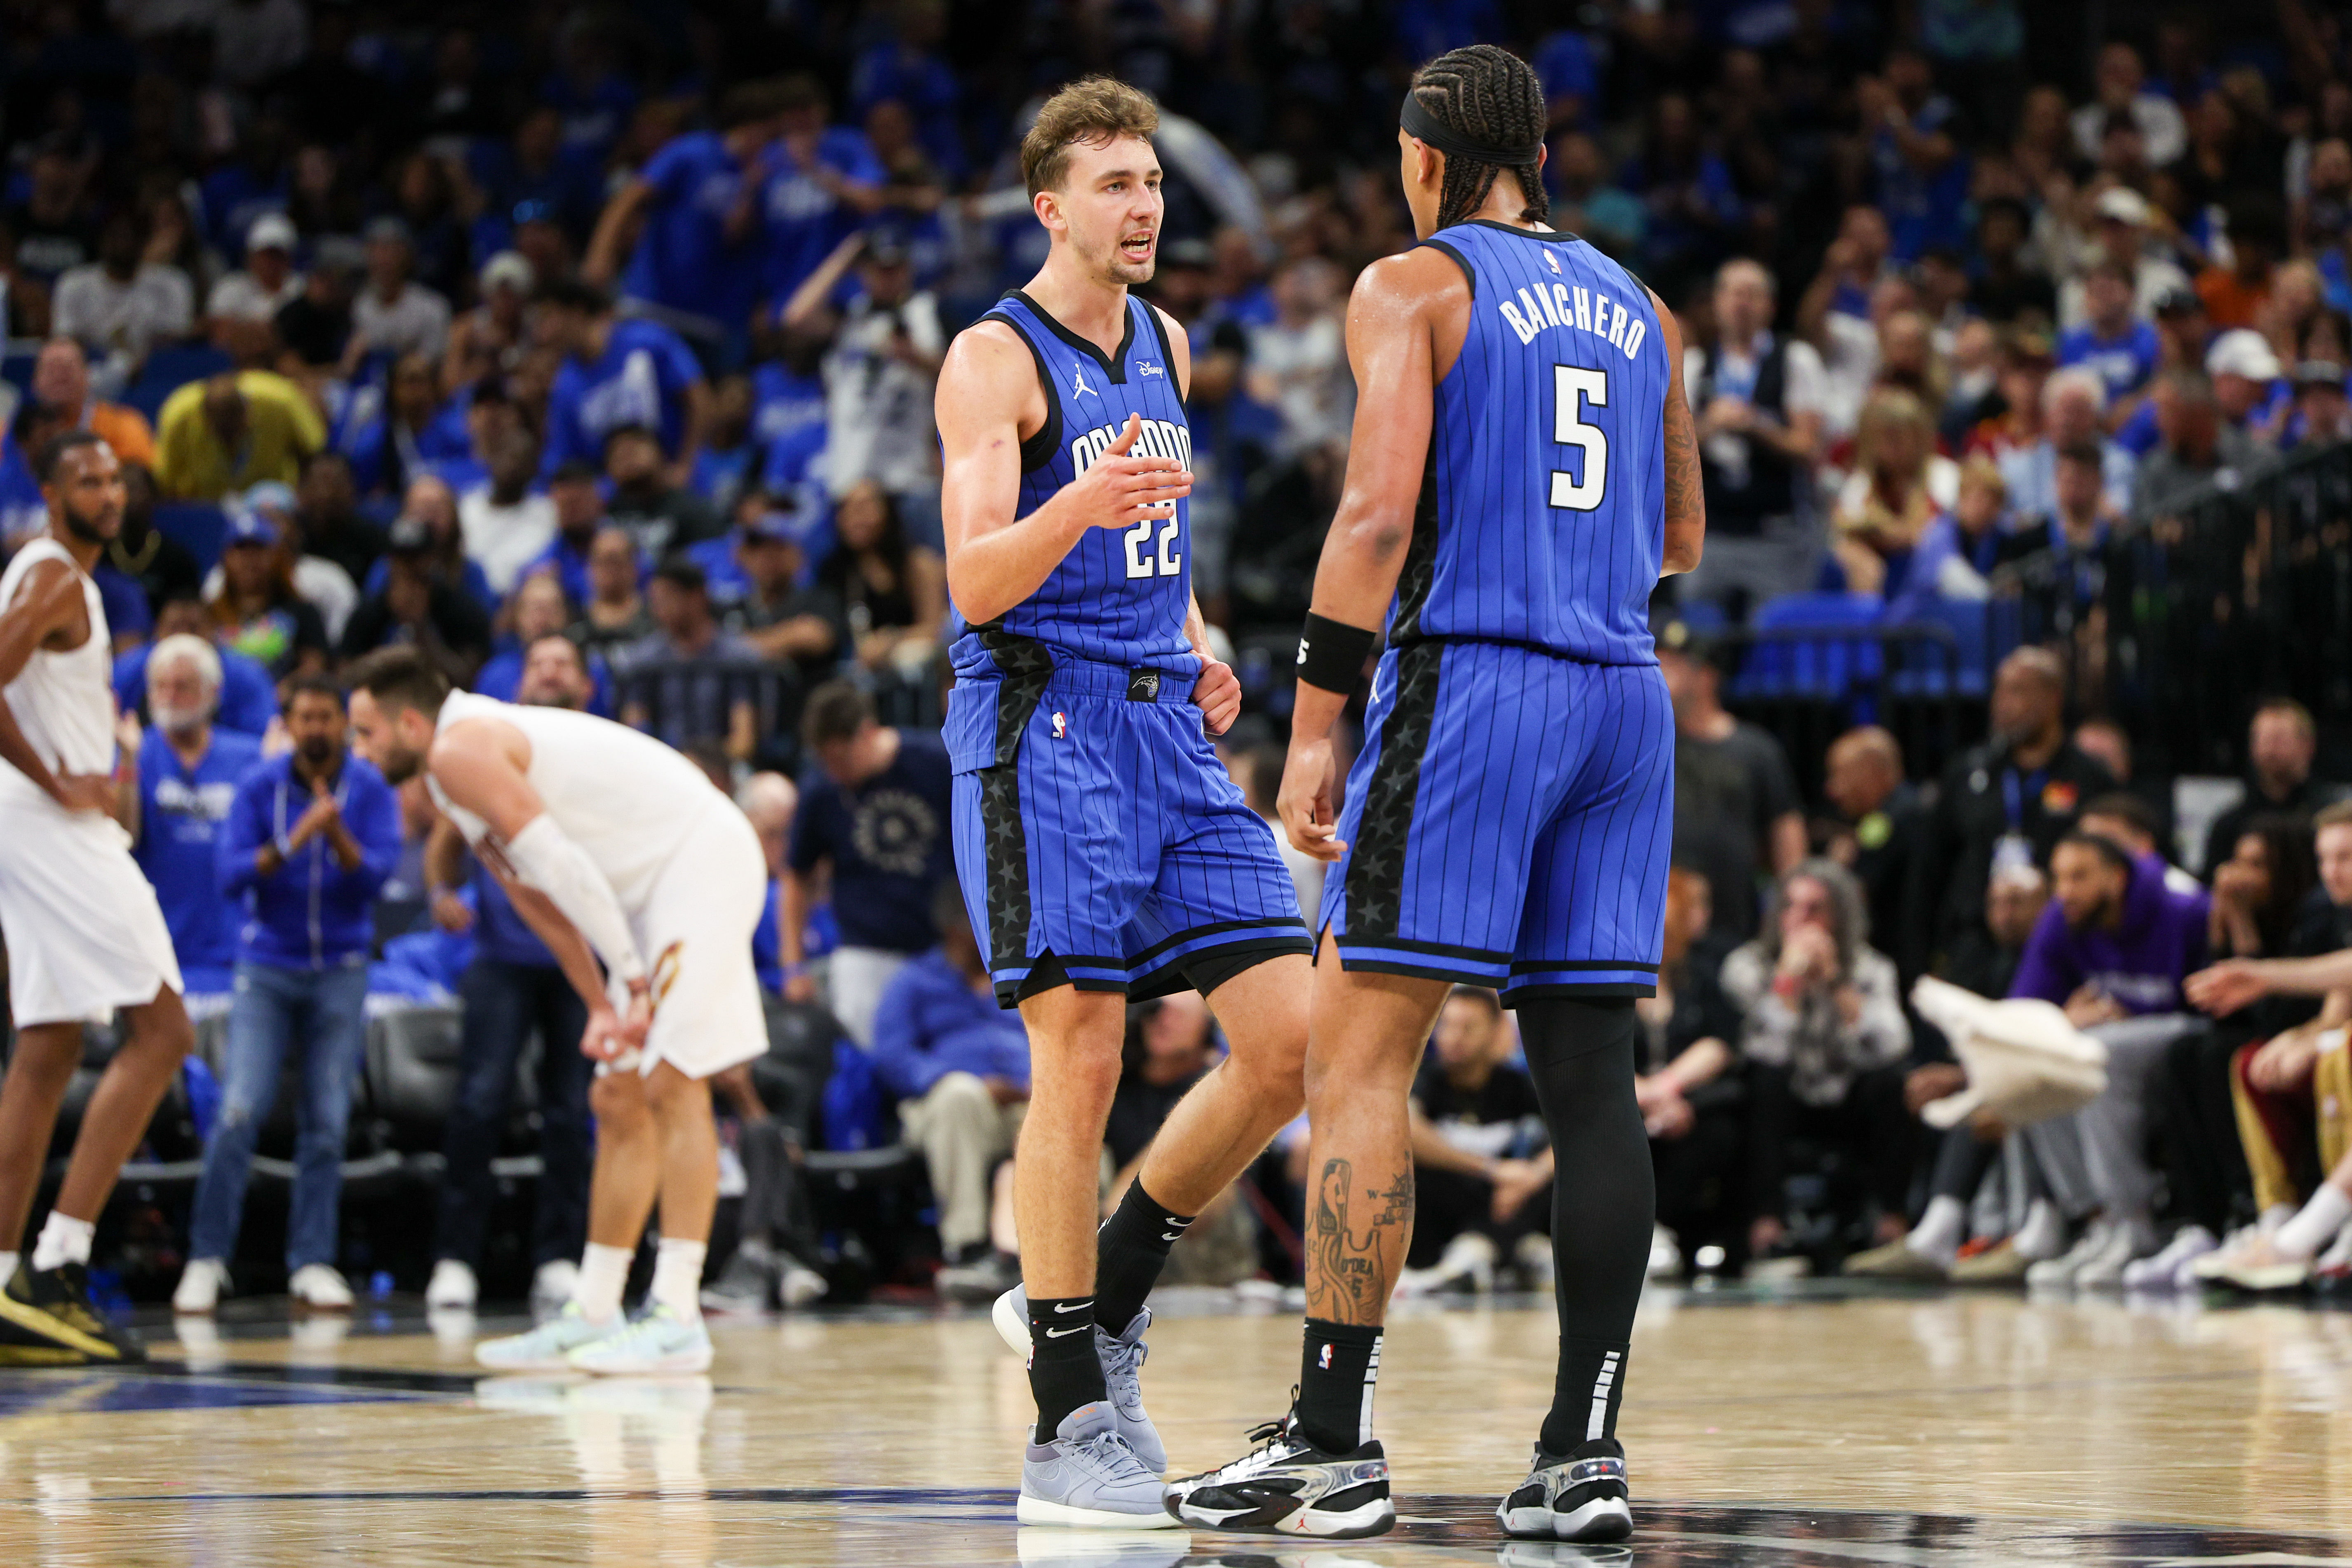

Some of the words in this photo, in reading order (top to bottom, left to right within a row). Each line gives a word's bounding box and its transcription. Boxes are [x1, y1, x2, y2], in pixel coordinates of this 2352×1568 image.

[1499, 282, 1646, 360] BANCHERO
[1548, 363, 1608, 512] 5
[1123, 497, 1182, 579] 22
